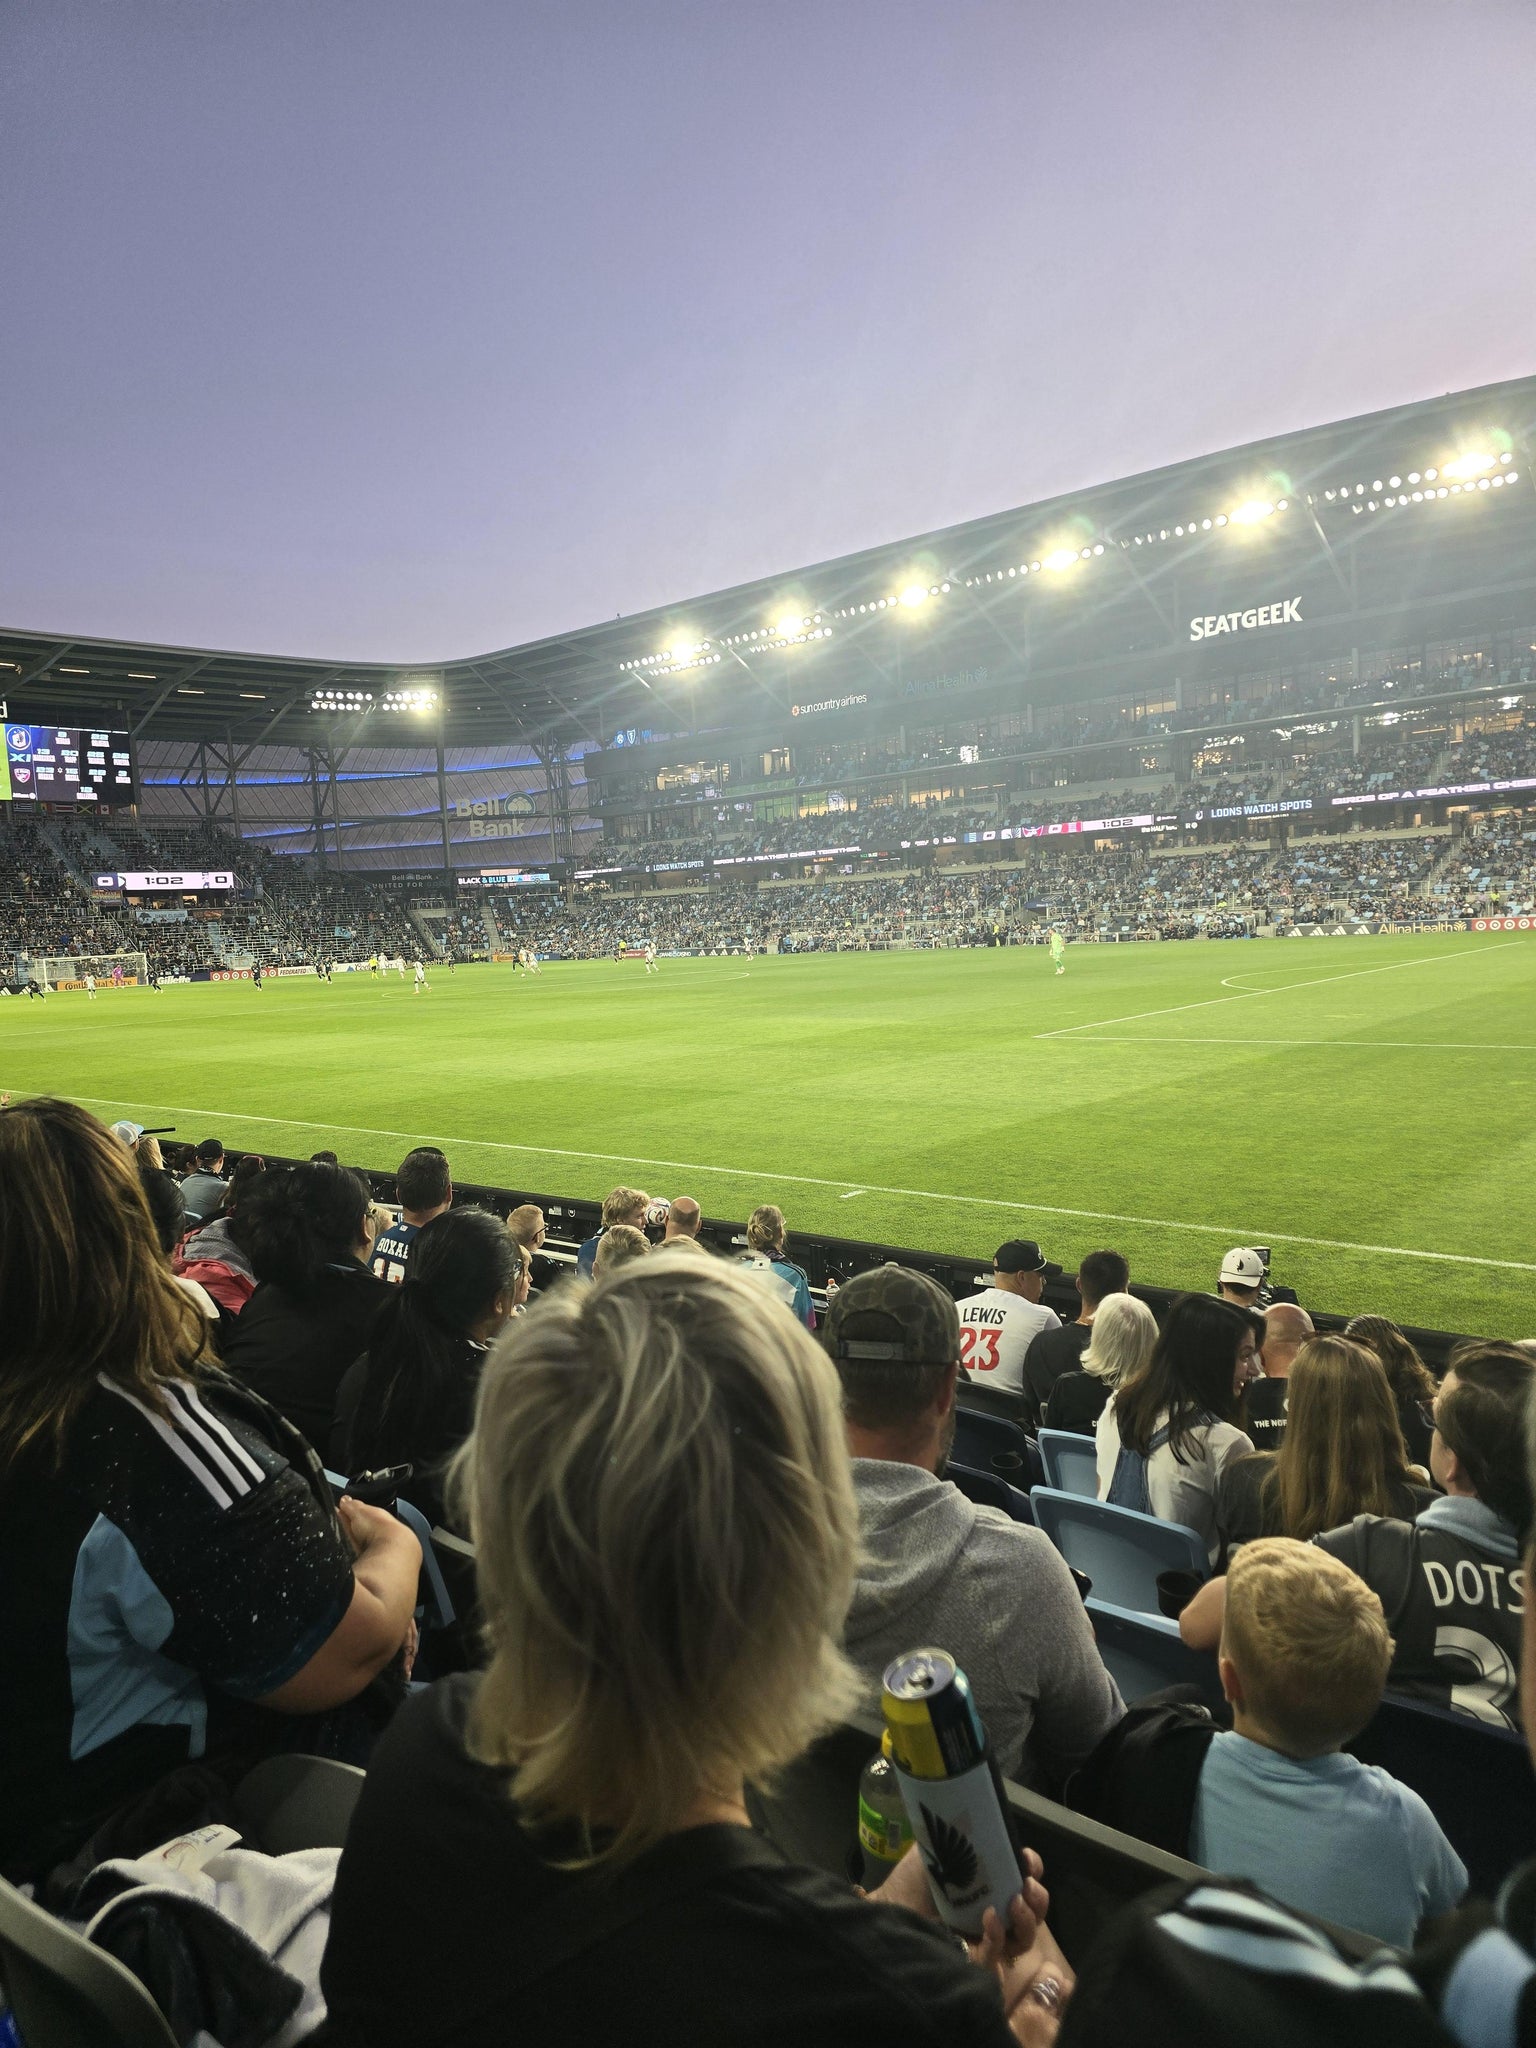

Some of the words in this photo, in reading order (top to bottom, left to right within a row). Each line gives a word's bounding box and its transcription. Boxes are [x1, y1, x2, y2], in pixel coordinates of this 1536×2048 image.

[1190, 596, 1303, 641] SEATGEEK
[800, 704, 813, 714] sun
[813, 699, 840, 712] country
[841, 695, 867, 706] airlines
[9, 753, 31, 762] XI
[1332, 795, 1376, 805] BIRDS
[1378, 793, 1399, 801] OF
[1401, 791, 1414, 799] A
[1416, 784, 1490, 797] FEATHER
[456, 799, 500, 817] Bell
[1211, 806, 1242, 818] LOONS
[1243, 803, 1278, 815] WATCH
[1280, 800, 1313, 811] SPOTS
[469, 819, 525, 837] Bank
[1101, 818, 1133, 828] 1:02
[754, 853, 788, 861] FEATHER
[790, 850, 816, 858] CHEER
[670, 862, 687, 870] WATCH
[688, 860, 704, 868] SPOTS
[144, 876, 184, 885] 1:02
[215, 876, 228, 884] 0
[1378, 922, 1412, 935] Allina
[1413, 921, 1453, 934] Health
[157, 975, 191, 985] Gillette
[962, 1307, 1007, 1324] LEWIS
[960, 1327, 1003, 1371] 23
[1253, 1420, 1270, 1428] THE
[1422, 1560, 1527, 1614] DOTS
